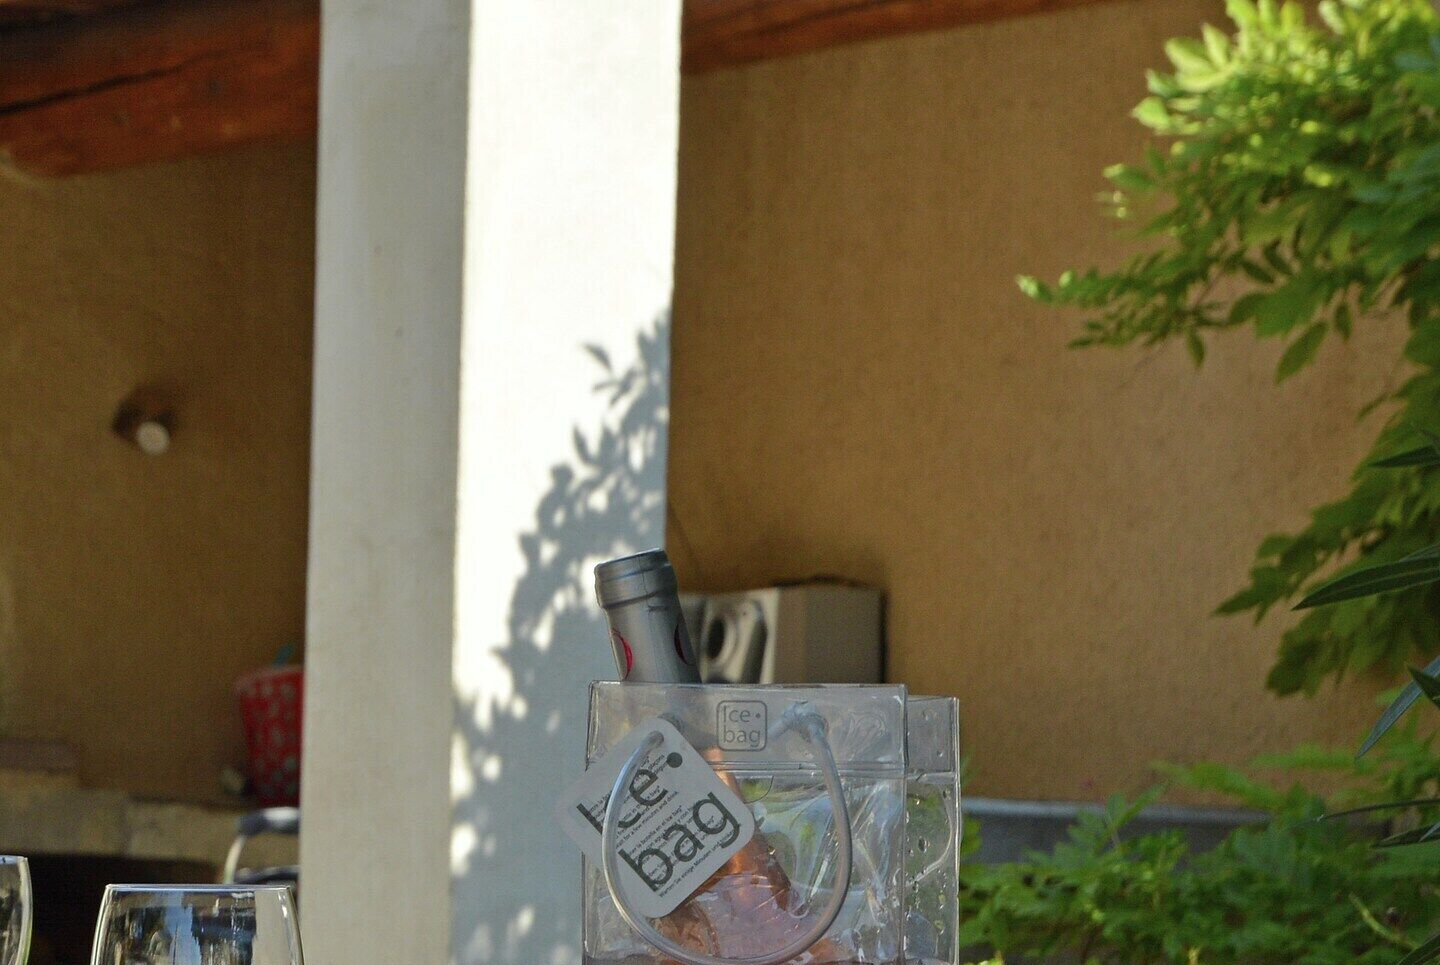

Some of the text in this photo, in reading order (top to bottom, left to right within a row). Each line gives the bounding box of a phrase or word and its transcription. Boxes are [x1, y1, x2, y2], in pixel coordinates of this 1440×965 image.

[723, 705, 751, 722] Ice
[723, 724, 760, 748] bag
[618, 792, 740, 893] bag
